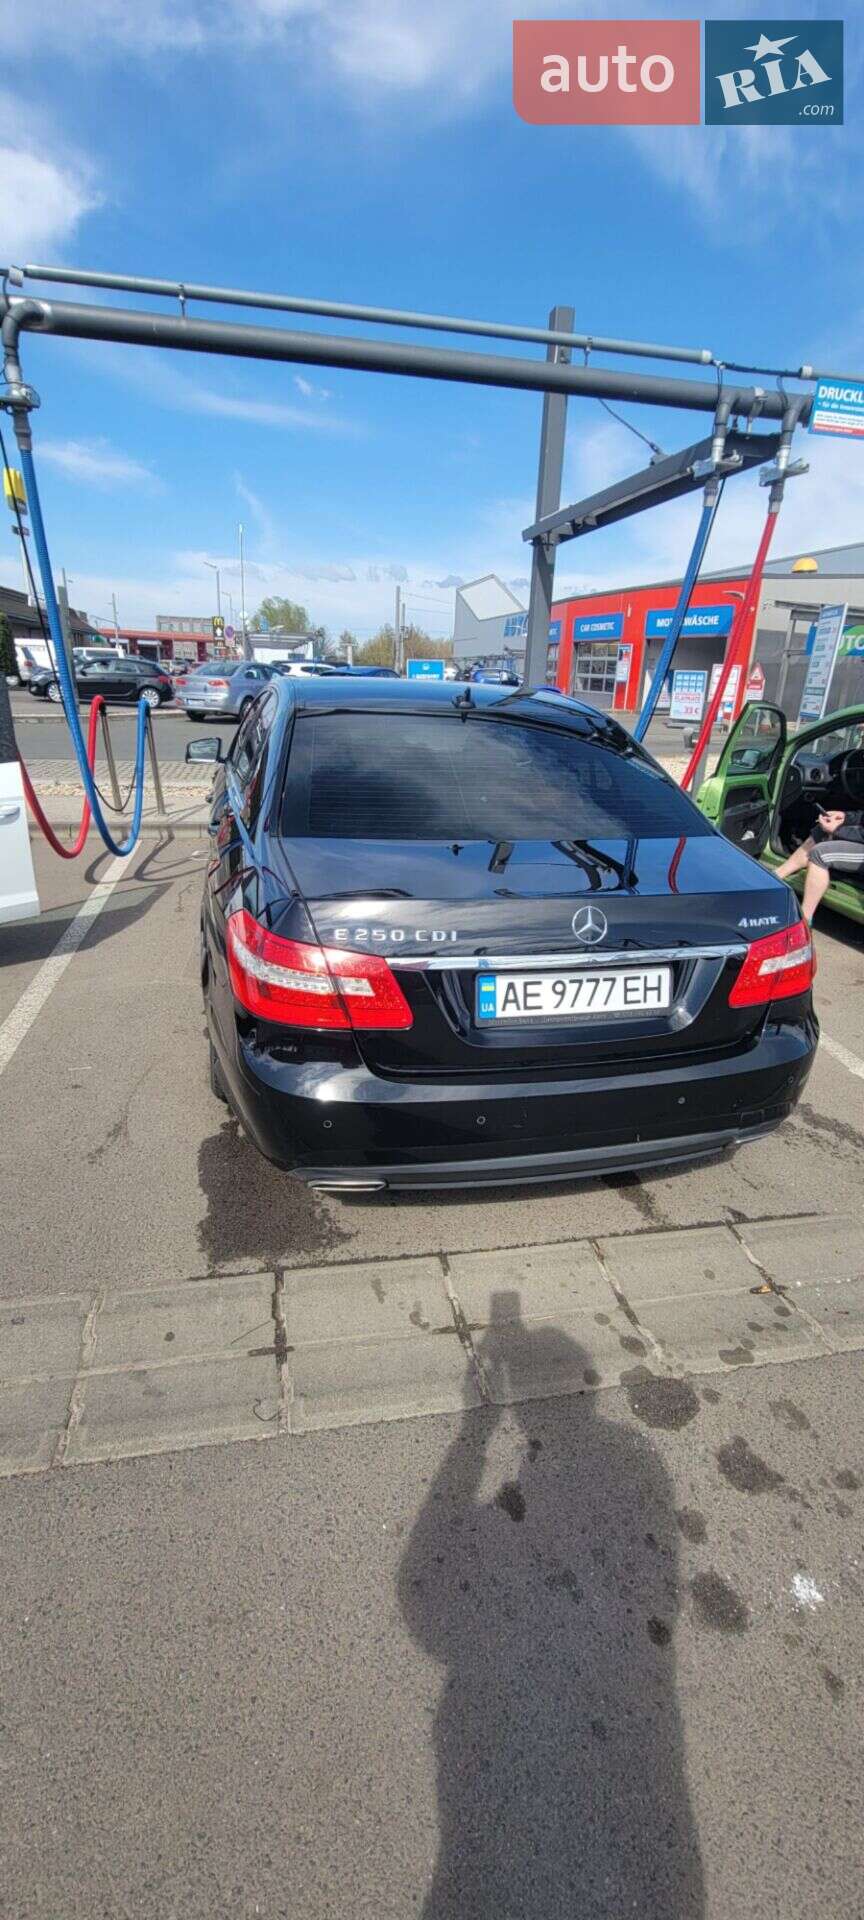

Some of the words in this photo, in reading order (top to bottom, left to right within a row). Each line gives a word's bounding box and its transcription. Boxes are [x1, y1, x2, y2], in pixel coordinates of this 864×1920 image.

[818, 385, 864, 403] DRUCKL
[333, 928, 348, 941] E
[355, 928, 404, 942] 250
[415, 930, 457, 942] CDI
[501, 981, 543, 1012] AE
[552, 977, 617, 1009] 9777
[623, 975, 662, 1006] EH
[481, 1002, 496, 1013] UA
